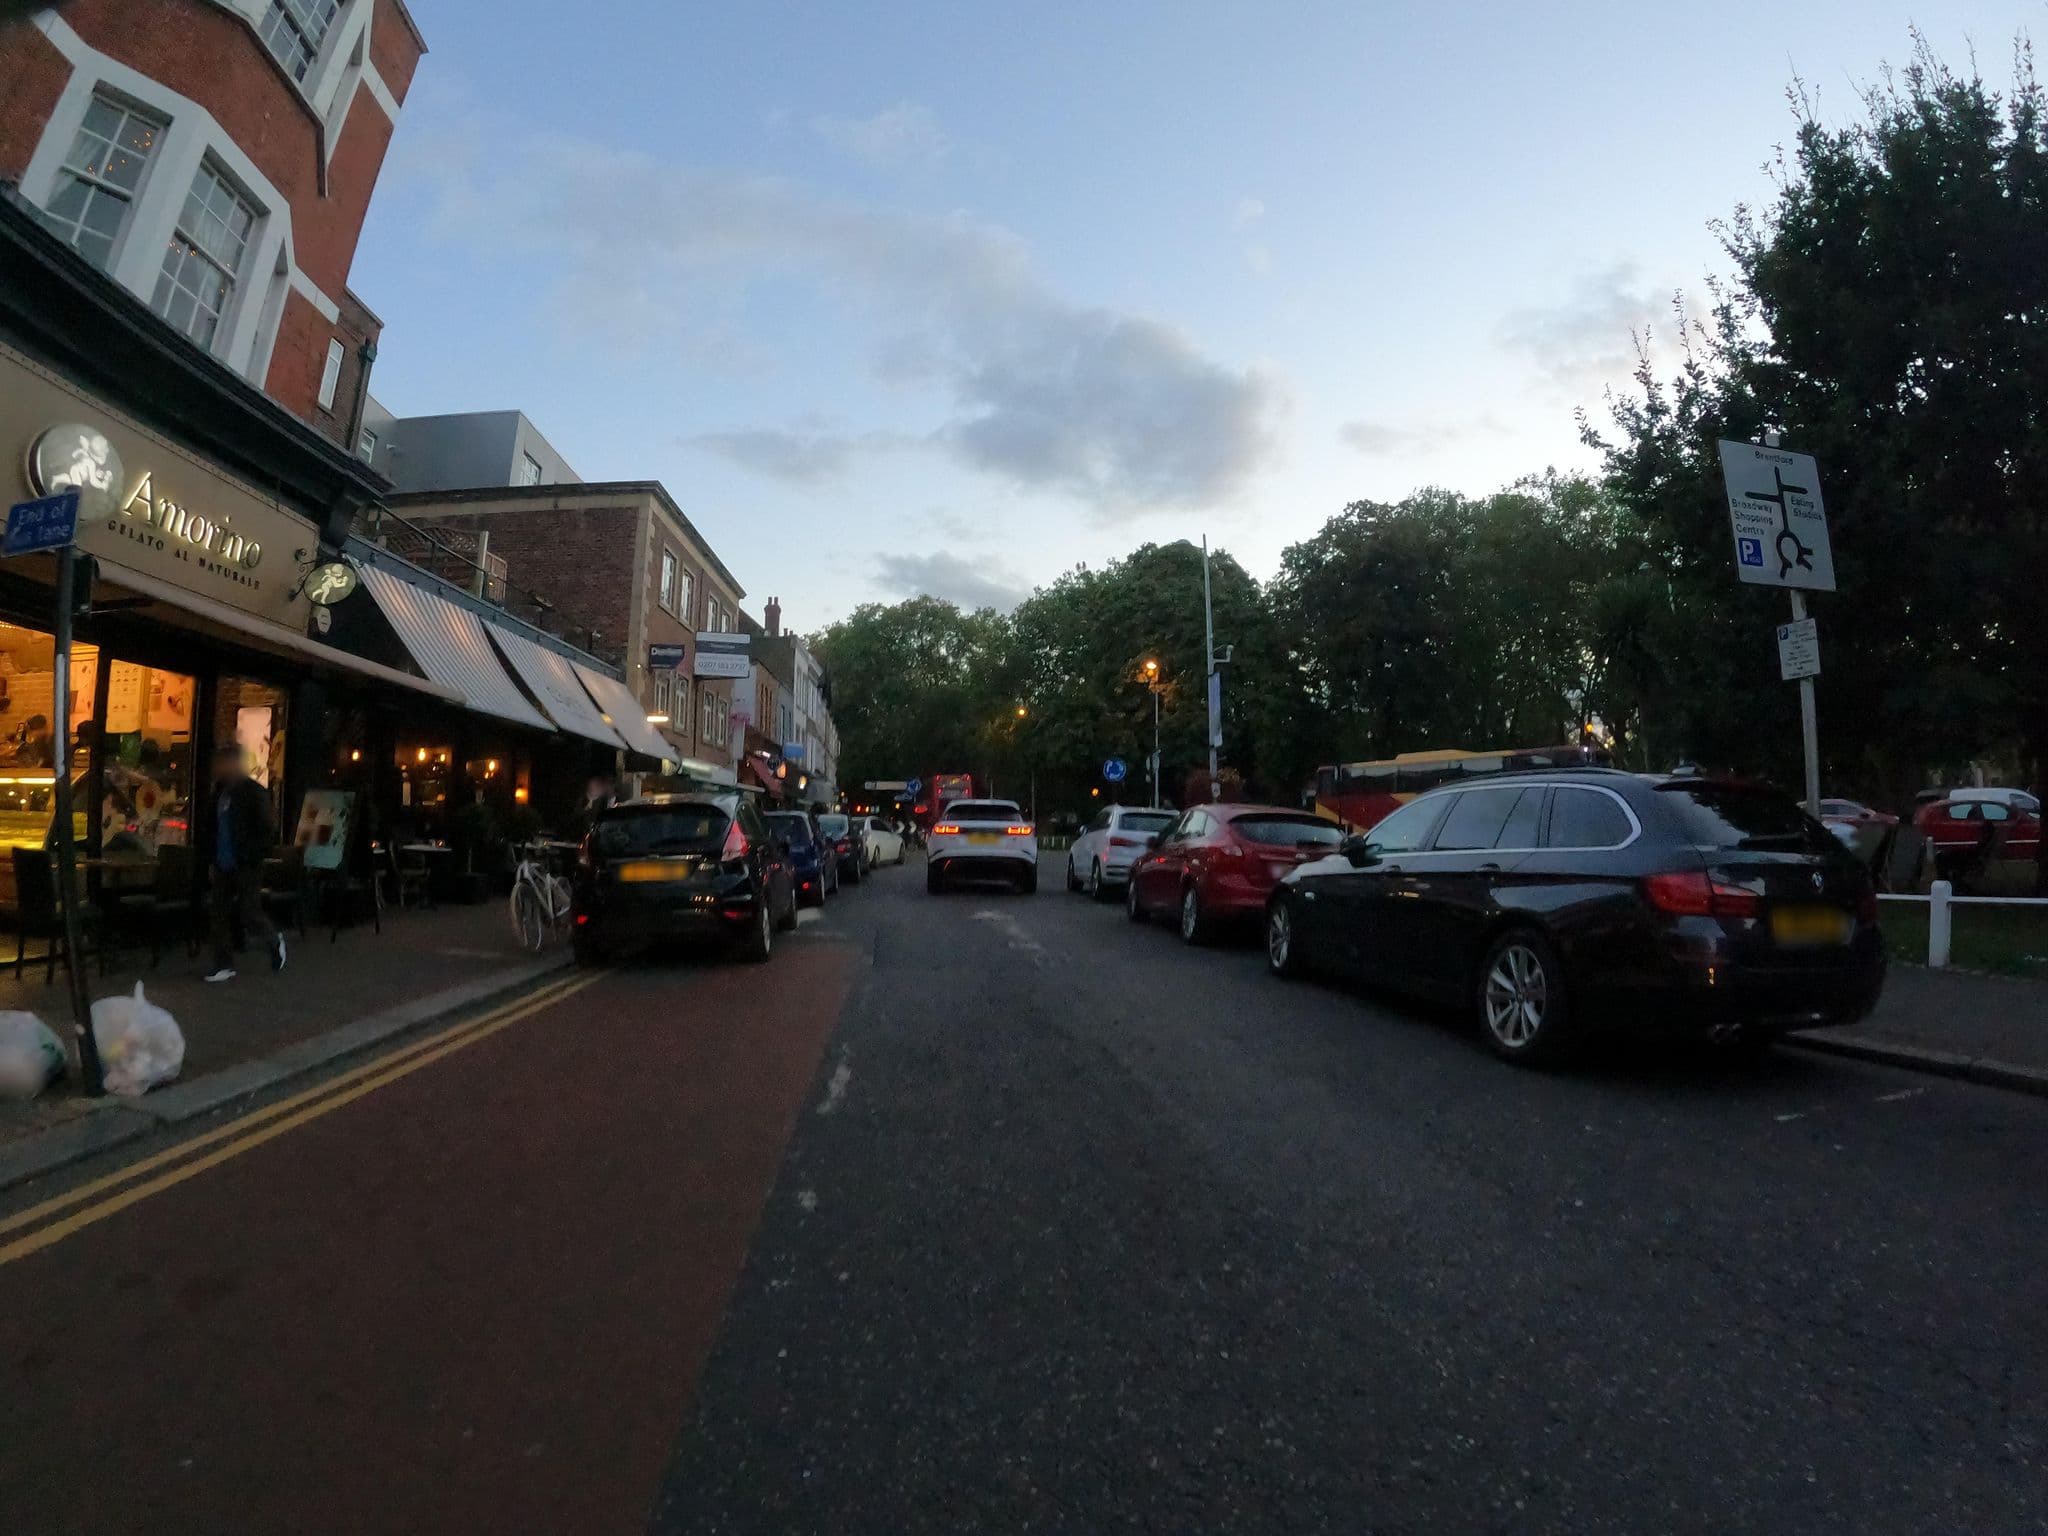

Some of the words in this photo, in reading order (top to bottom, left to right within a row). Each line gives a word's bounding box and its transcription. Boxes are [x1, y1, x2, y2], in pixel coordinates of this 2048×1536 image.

[1731, 498, 1773, 514] Broadway
[122, 471, 262, 570] Amorino
[1734, 511, 1774, 526] Shopping
[1736, 524, 1765, 535] Centre
[107, 519, 164, 550] GELATO
[174, 548, 189, 562] AL
[198, 557, 261, 590] NATURALE
[1742, 541, 1754, 562] P
